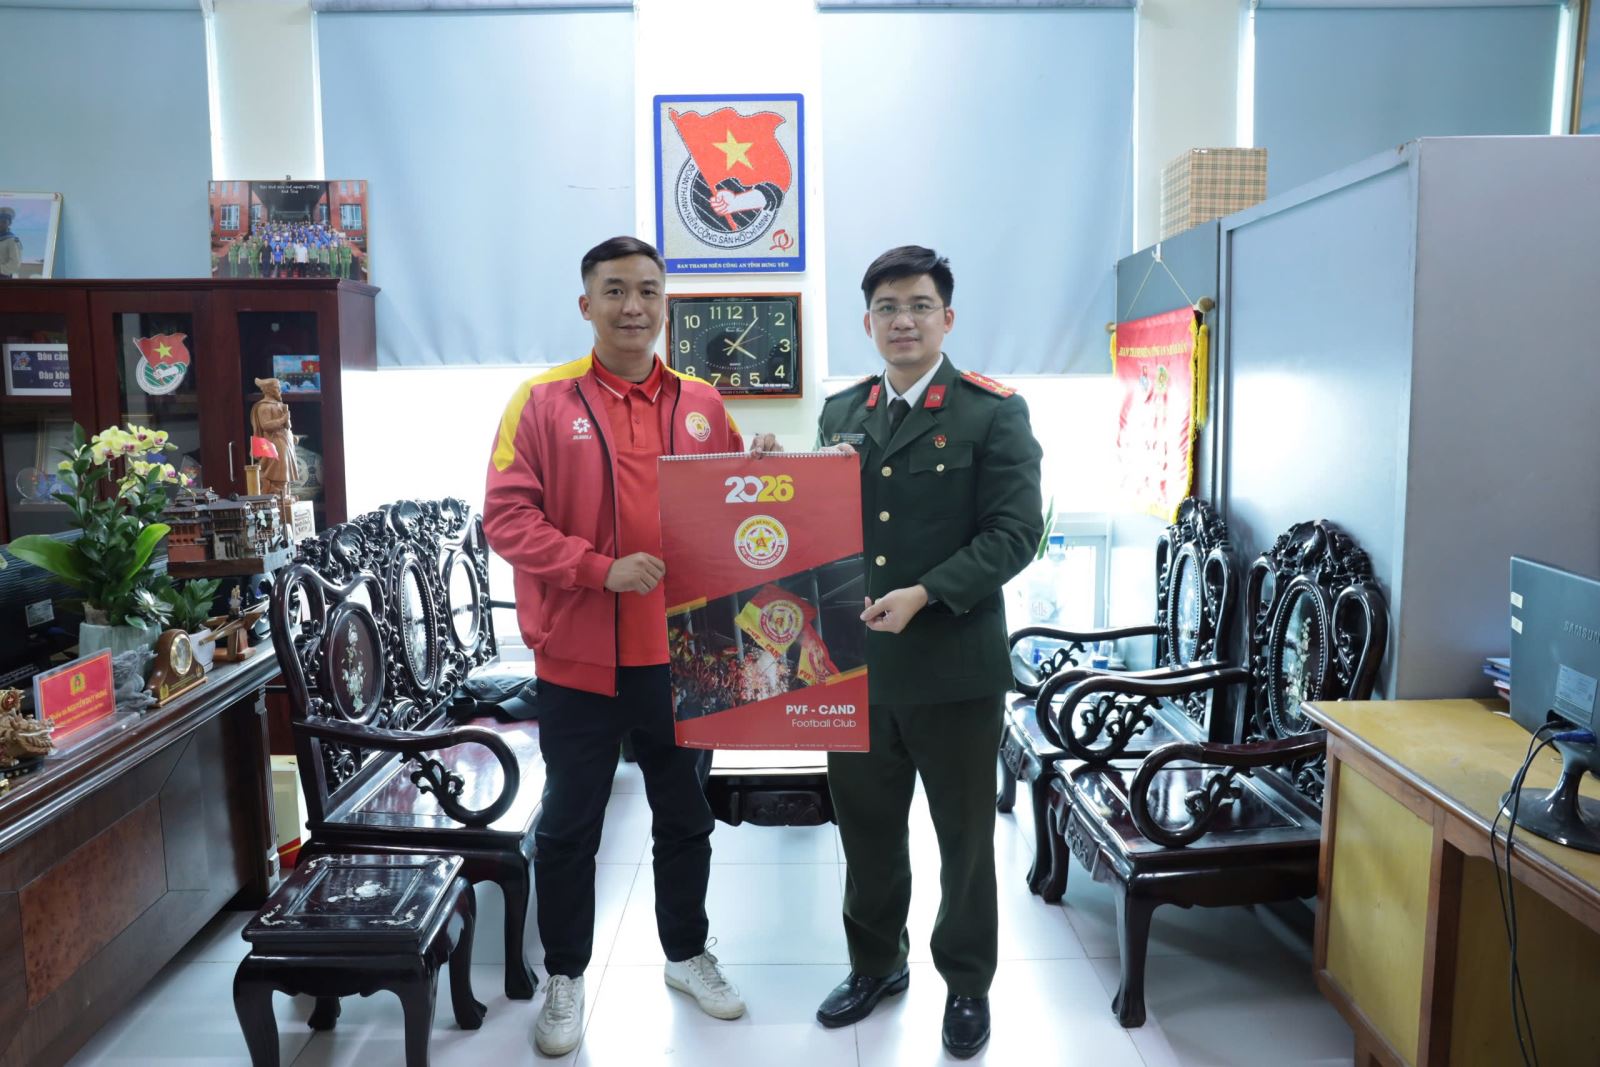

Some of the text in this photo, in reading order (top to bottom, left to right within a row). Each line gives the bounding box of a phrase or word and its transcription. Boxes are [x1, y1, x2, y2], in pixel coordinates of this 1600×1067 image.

[680, 186, 689, 211] THANH
[710, 306, 721, 320] 11
[726, 306, 743, 320] 12
[752, 306, 758, 318] 1
[684, 315, 700, 328] 10
[774, 312, 785, 326] 2
[680, 340, 690, 354] 9
[780, 339, 790, 352] 3
[685, 366, 696, 378] 8
[774, 365, 786, 378] 4
[711, 374, 721, 387] 7
[730, 373, 740, 386] 6
[750, 372, 760, 386] 5
[724, 474, 794, 503] 2026
[786, 704, 808, 714] PVF
[818, 704, 856, 714] CAND
[792, 719, 856, 728] Football Club
